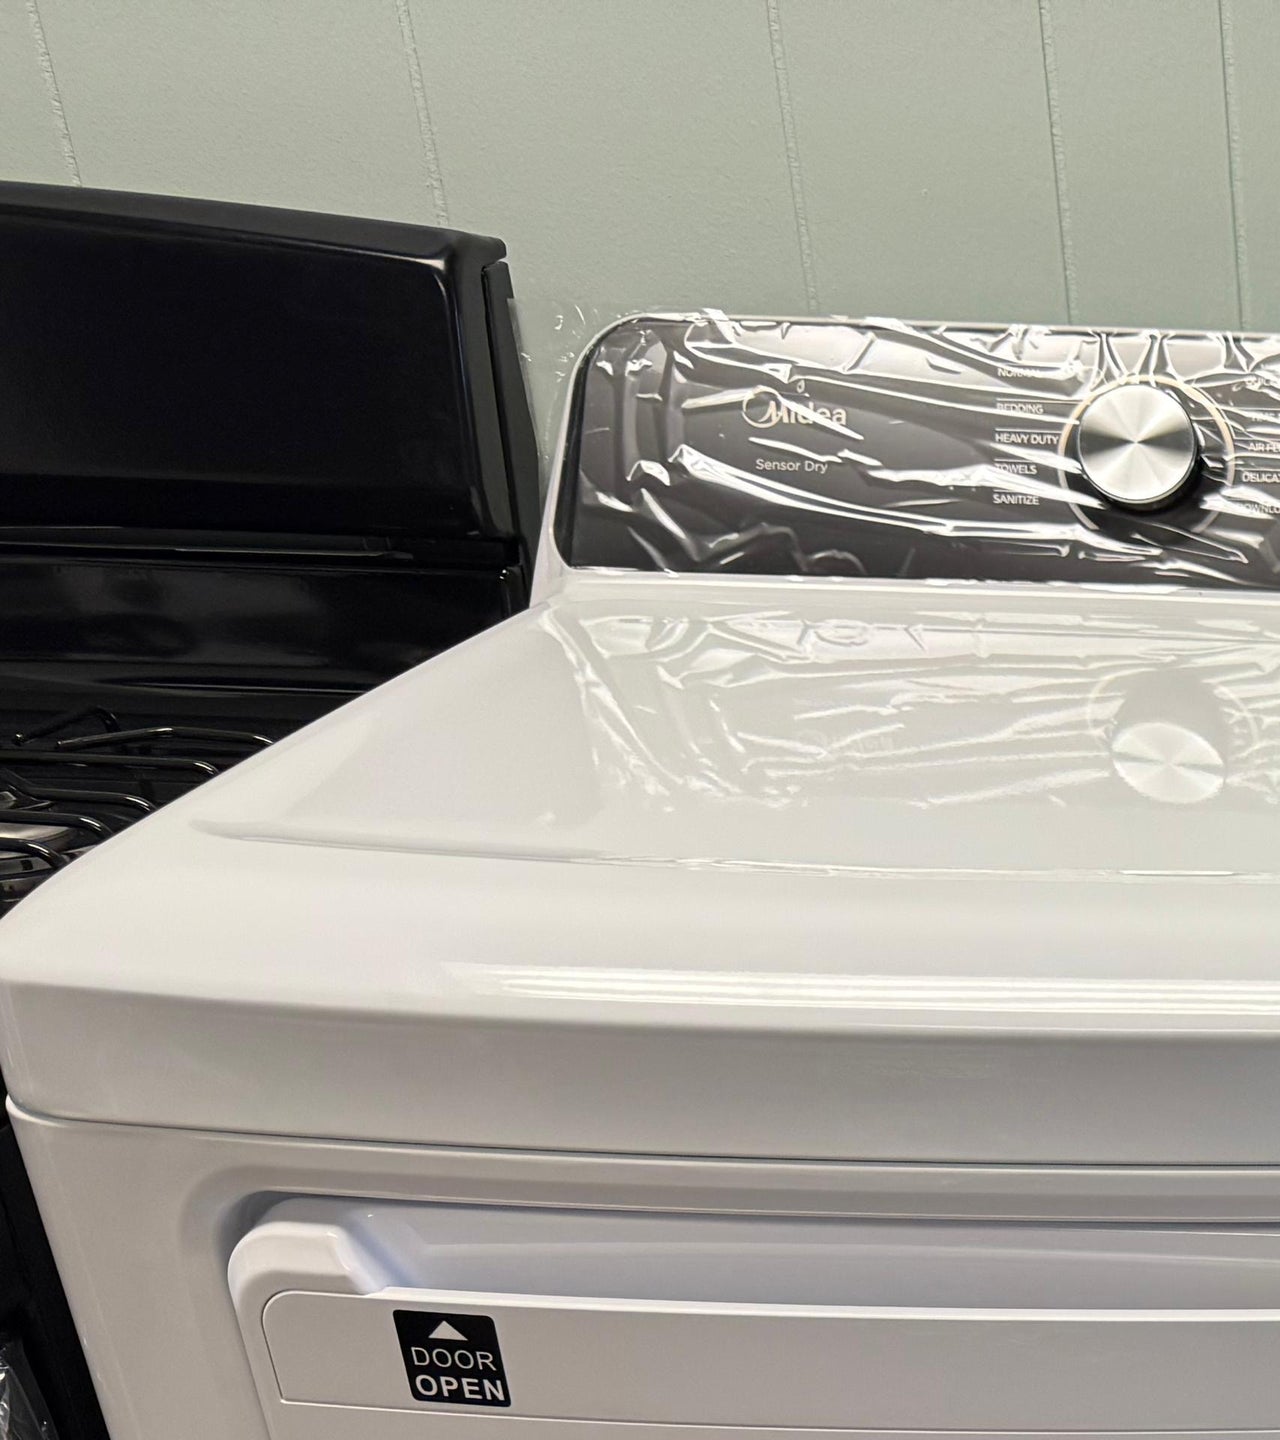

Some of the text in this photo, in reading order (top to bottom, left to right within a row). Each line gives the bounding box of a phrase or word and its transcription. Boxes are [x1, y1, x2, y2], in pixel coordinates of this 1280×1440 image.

[742, 385, 847, 428] Midea
[995, 433, 1059, 445] HEAVY DUTY
[756, 458, 828, 474] Sensor Dry
[993, 495, 1040, 505] SANITIZE
[411, 1346, 497, 1371] DOOR
[415, 1375, 505, 1401] OPEN
